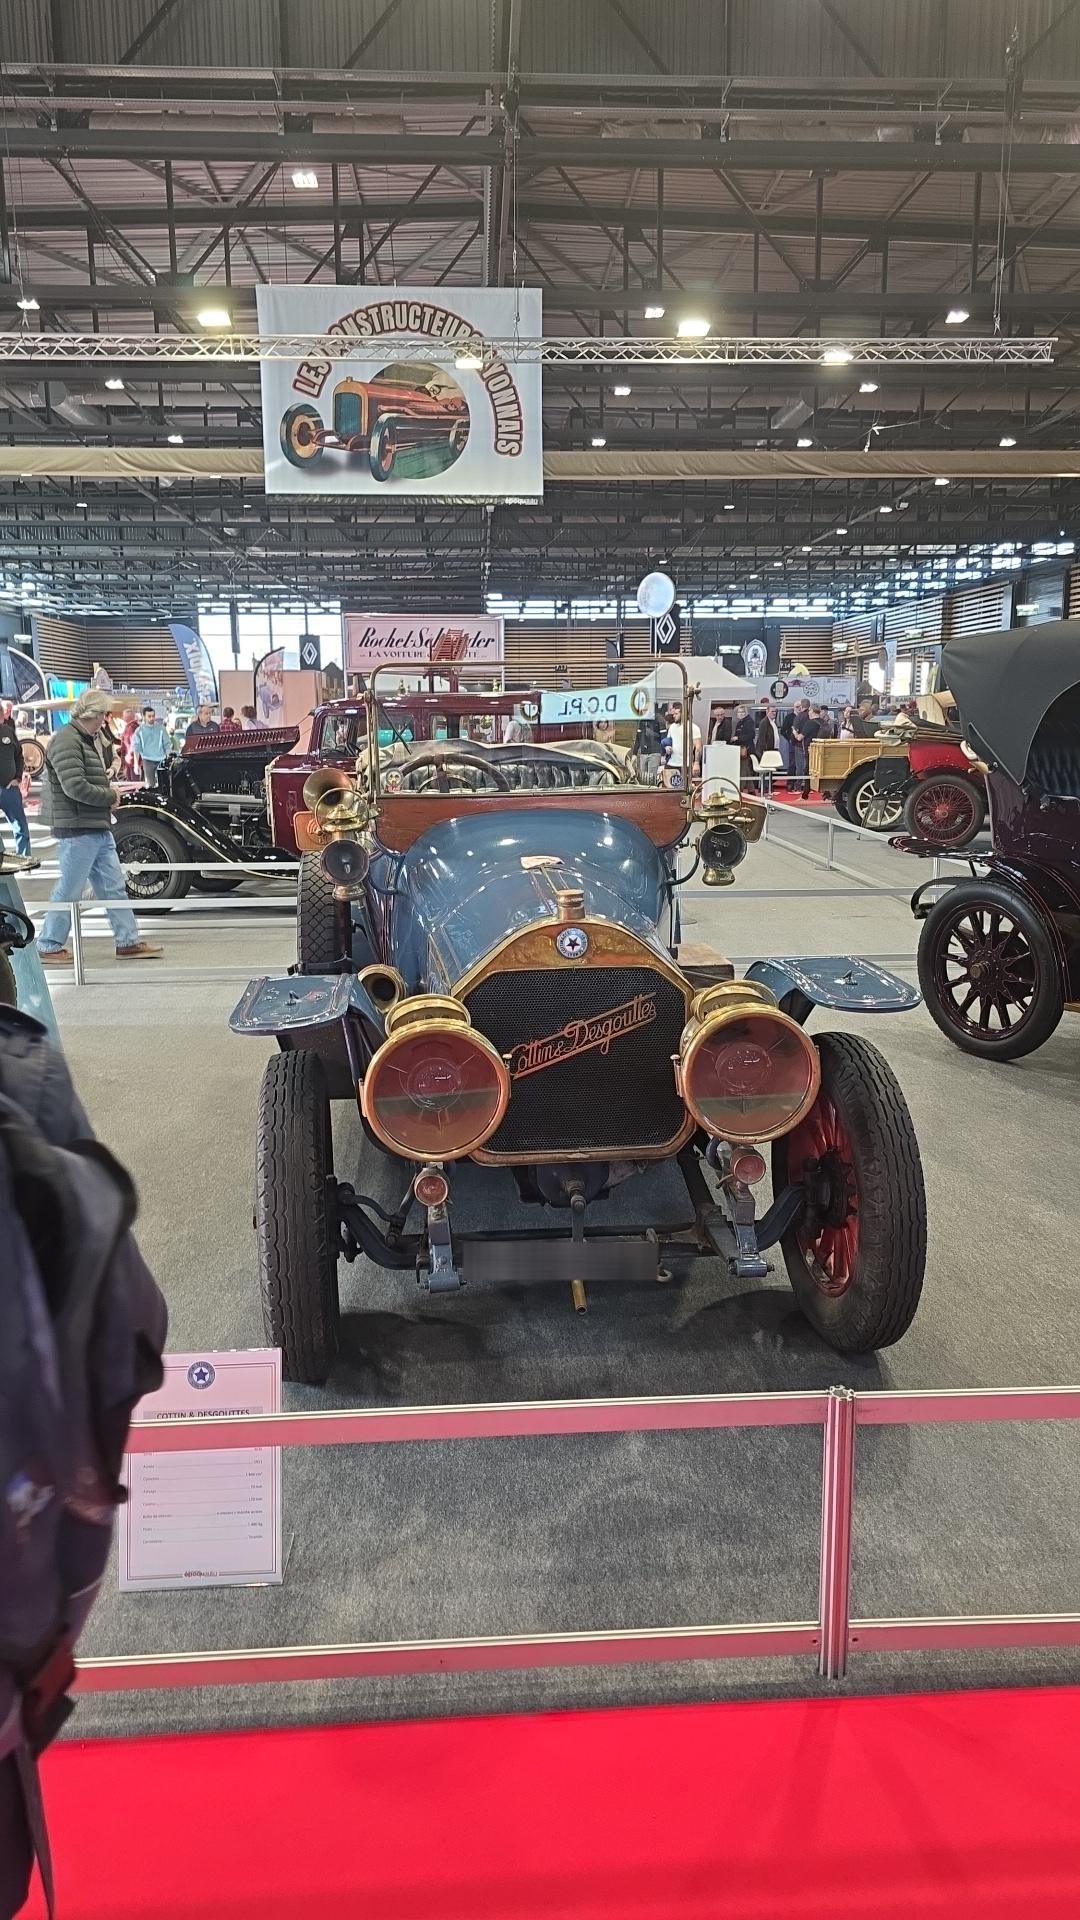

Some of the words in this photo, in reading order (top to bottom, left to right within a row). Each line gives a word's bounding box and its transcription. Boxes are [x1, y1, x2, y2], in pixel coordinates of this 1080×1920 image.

[293, 354, 331, 398] LES
[156, 1412, 187, 1420] COTTIN
[197, 1409, 250, 1418] DESGOUTTES
